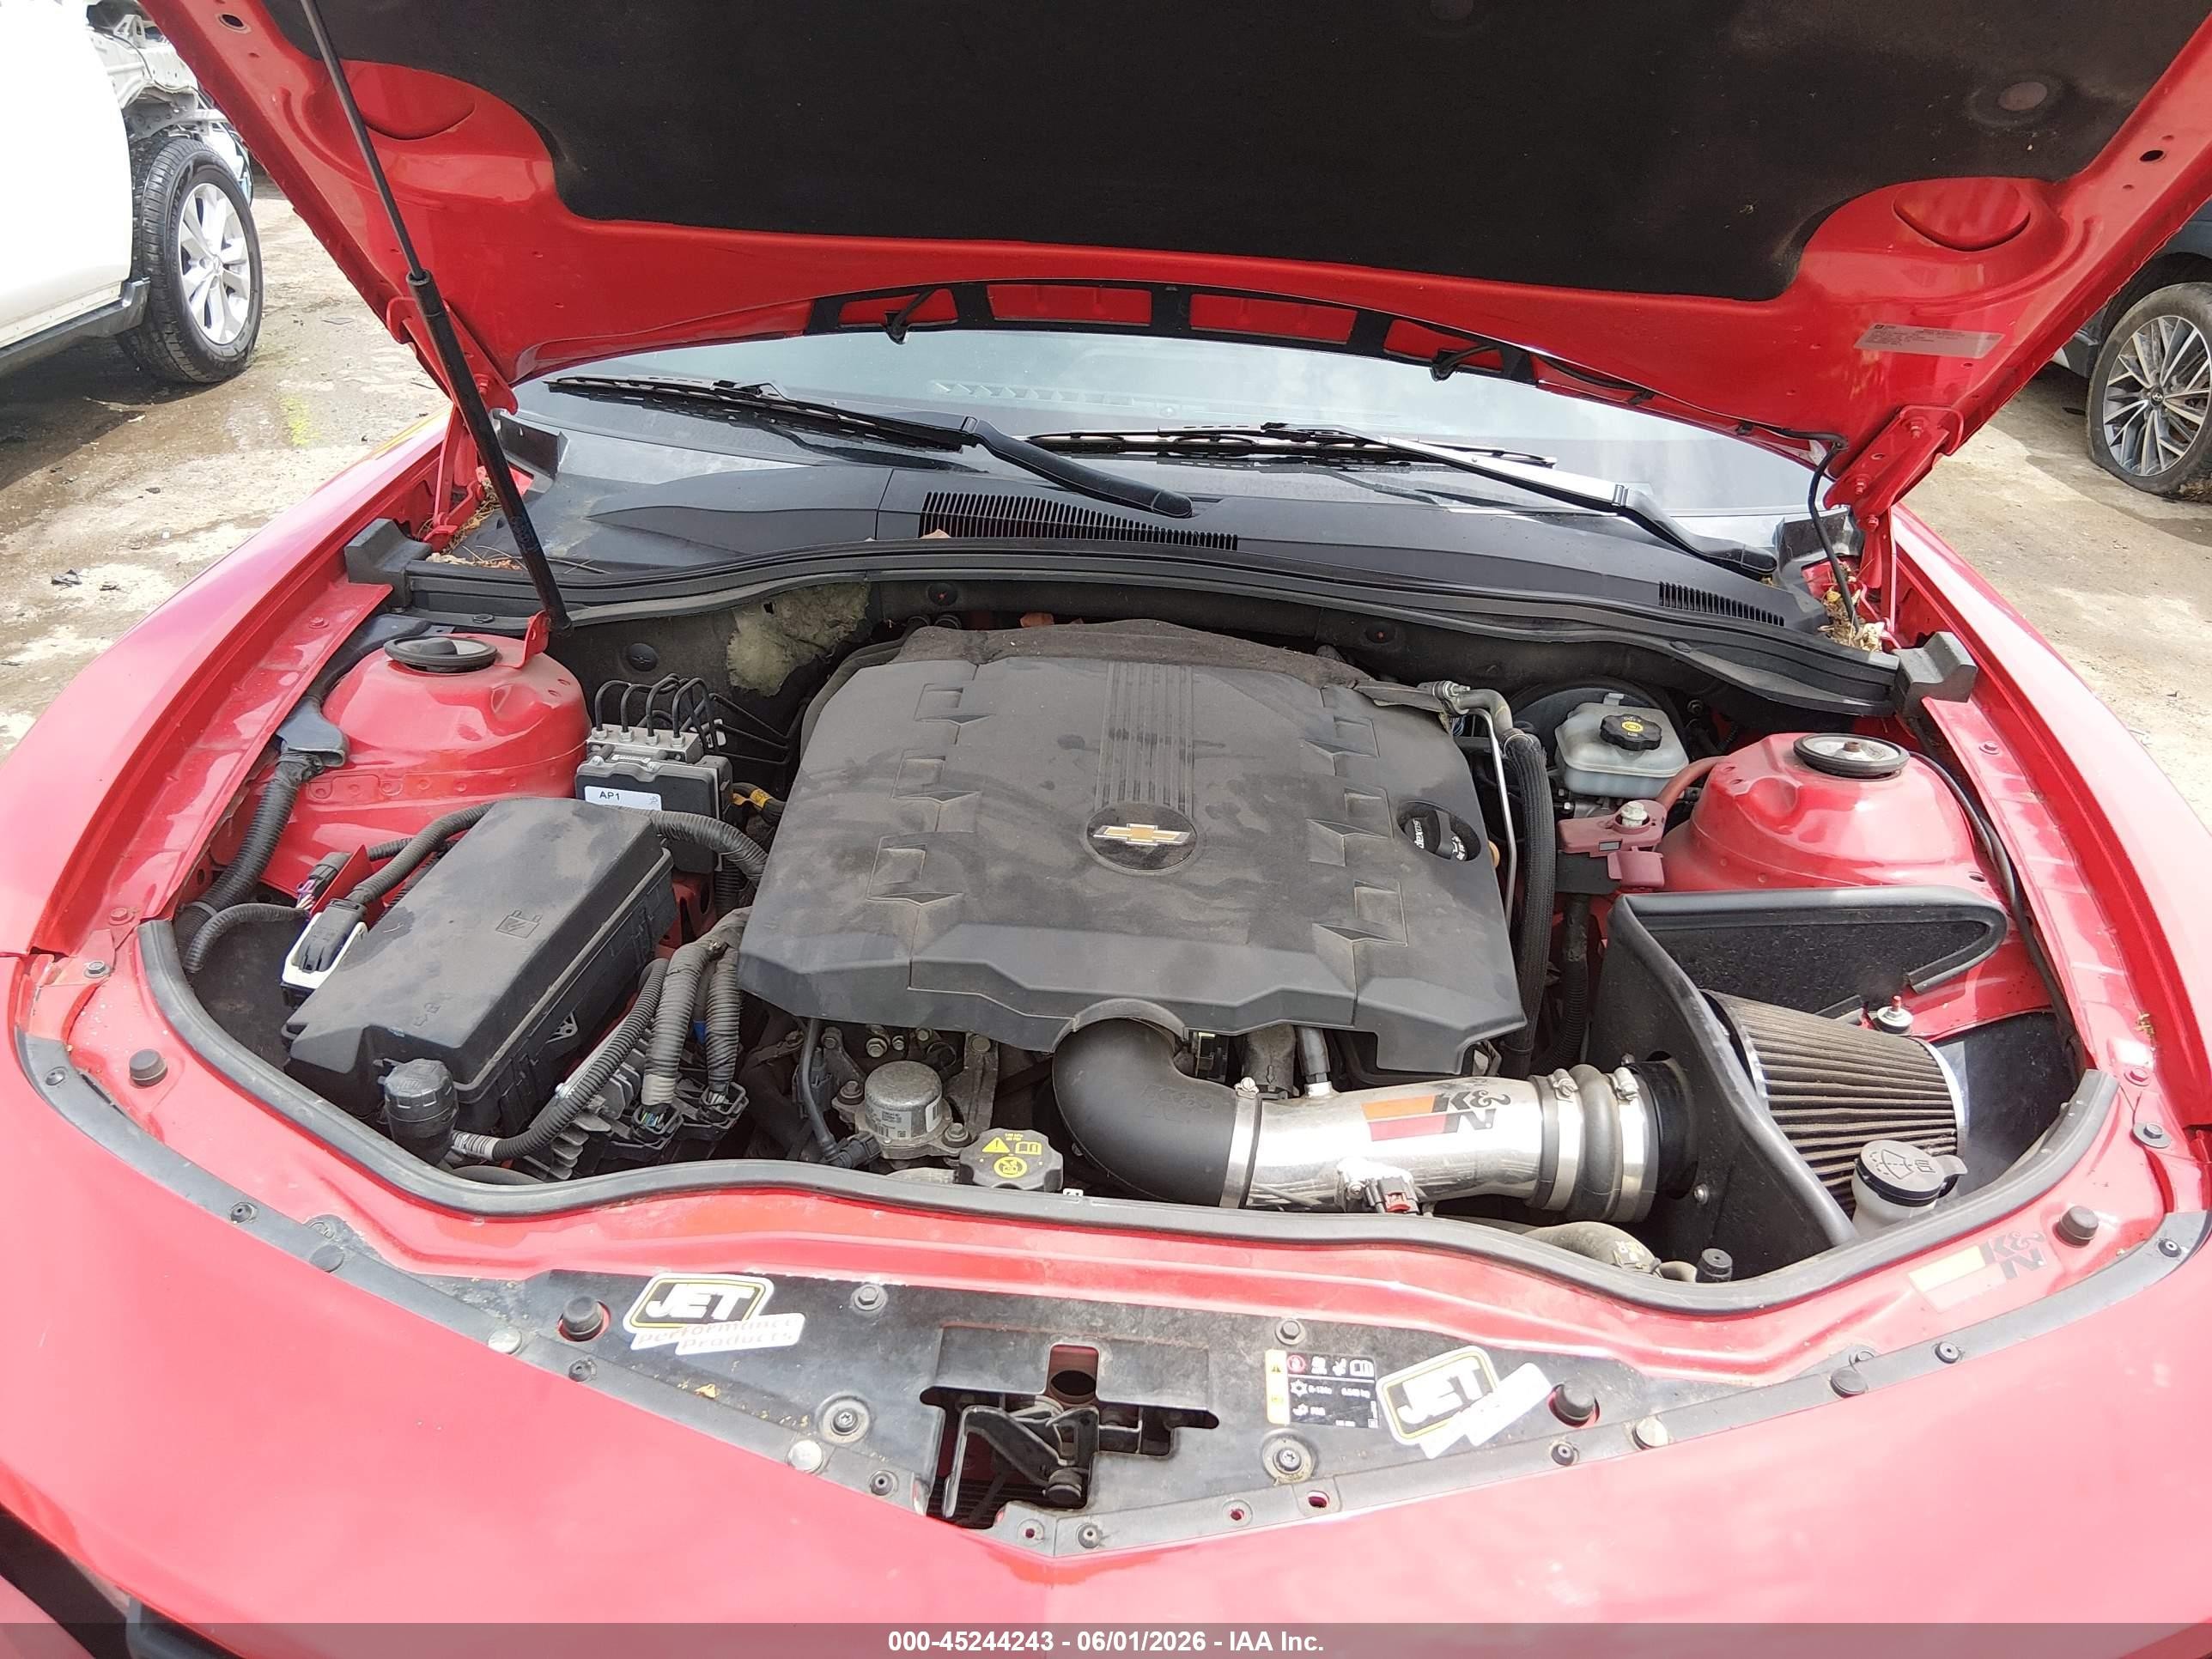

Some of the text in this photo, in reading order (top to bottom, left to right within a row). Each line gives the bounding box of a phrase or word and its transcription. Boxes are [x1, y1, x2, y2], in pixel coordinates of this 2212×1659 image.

[599, 790, 620, 801] AP1
[1412, 817, 1425, 849] dexos
[645, 1283, 757, 1321] JET
[1395, 1357, 1482, 1424] JET
